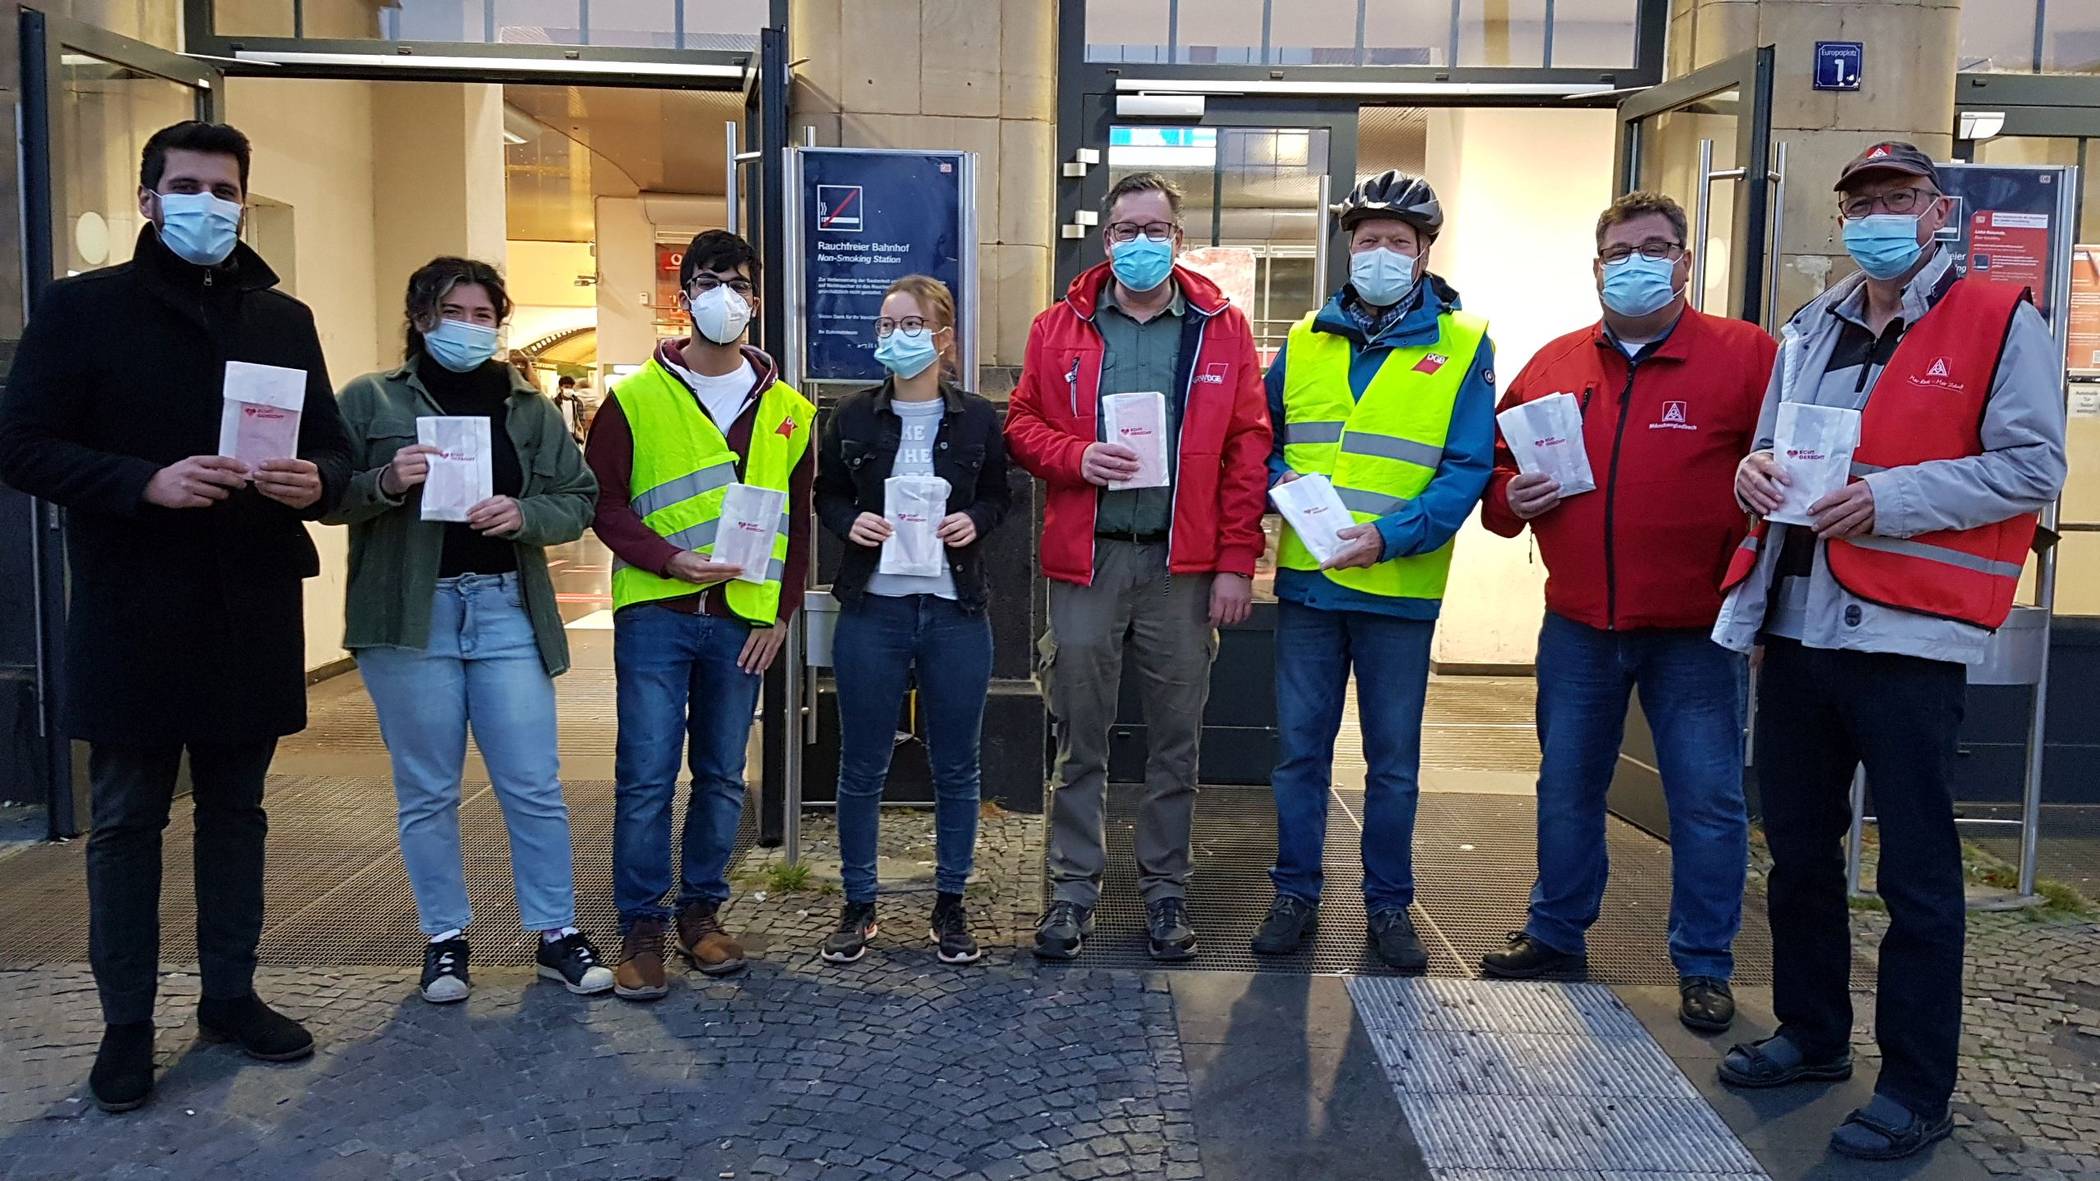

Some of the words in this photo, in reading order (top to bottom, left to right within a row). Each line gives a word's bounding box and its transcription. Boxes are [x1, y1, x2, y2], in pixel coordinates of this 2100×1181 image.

[1834, 58, 1844, 82] 1
[818, 241, 869, 251] Rauchfreier
[872, 242, 910, 253] Bahnhof
[817, 254, 871, 264] Non-Smoking
[873, 255, 902, 264] Station
[1427, 353, 1446, 364] DGB
